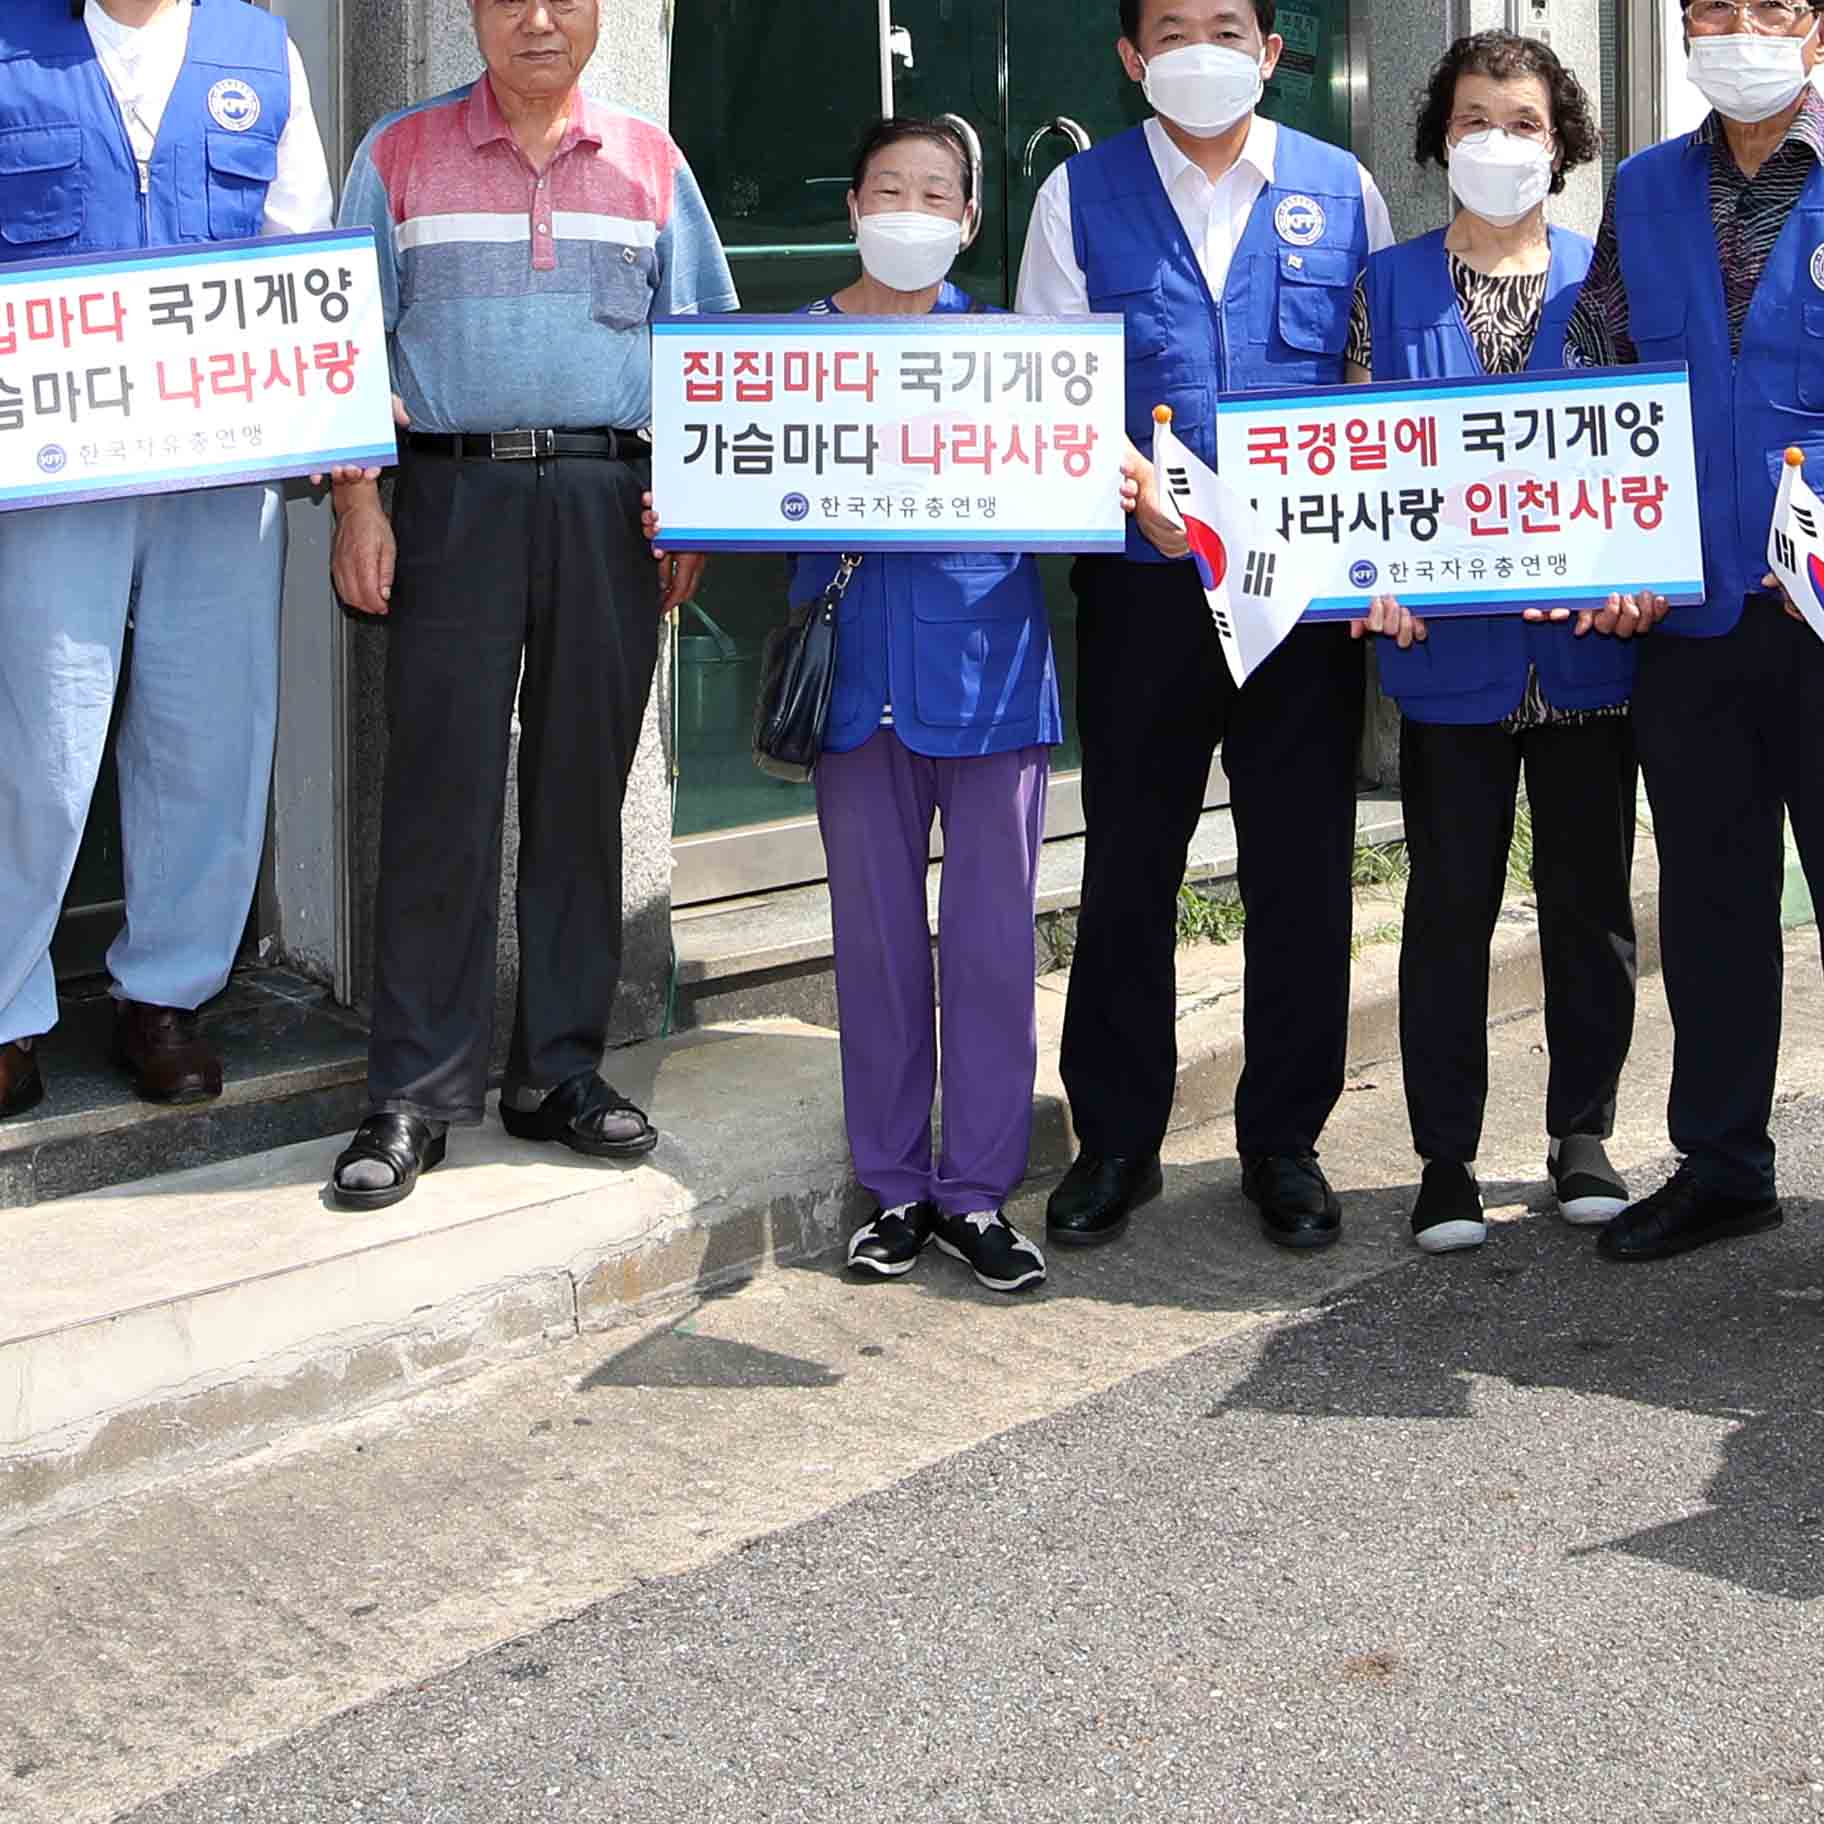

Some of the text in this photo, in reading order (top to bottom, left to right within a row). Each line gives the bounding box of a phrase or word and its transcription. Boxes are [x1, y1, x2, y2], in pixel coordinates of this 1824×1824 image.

[148, 266, 353, 336] 국기게양
[156, 340, 360, 408] 나라사랑
[682, 349, 1099, 407] 집집마다 국기게양
[78, 423, 264, 465] 한국자유총연맹
[682, 423, 1099, 478] 가슴마다 나라사랑
[1246, 400, 1665, 476] 국경일에 국기게양
[820, 495, 998, 520] 한국자유총연맹
[1464, 475, 1670, 537] 인천사랑
[1388, 552, 1568, 584] 한국자유총연맹
